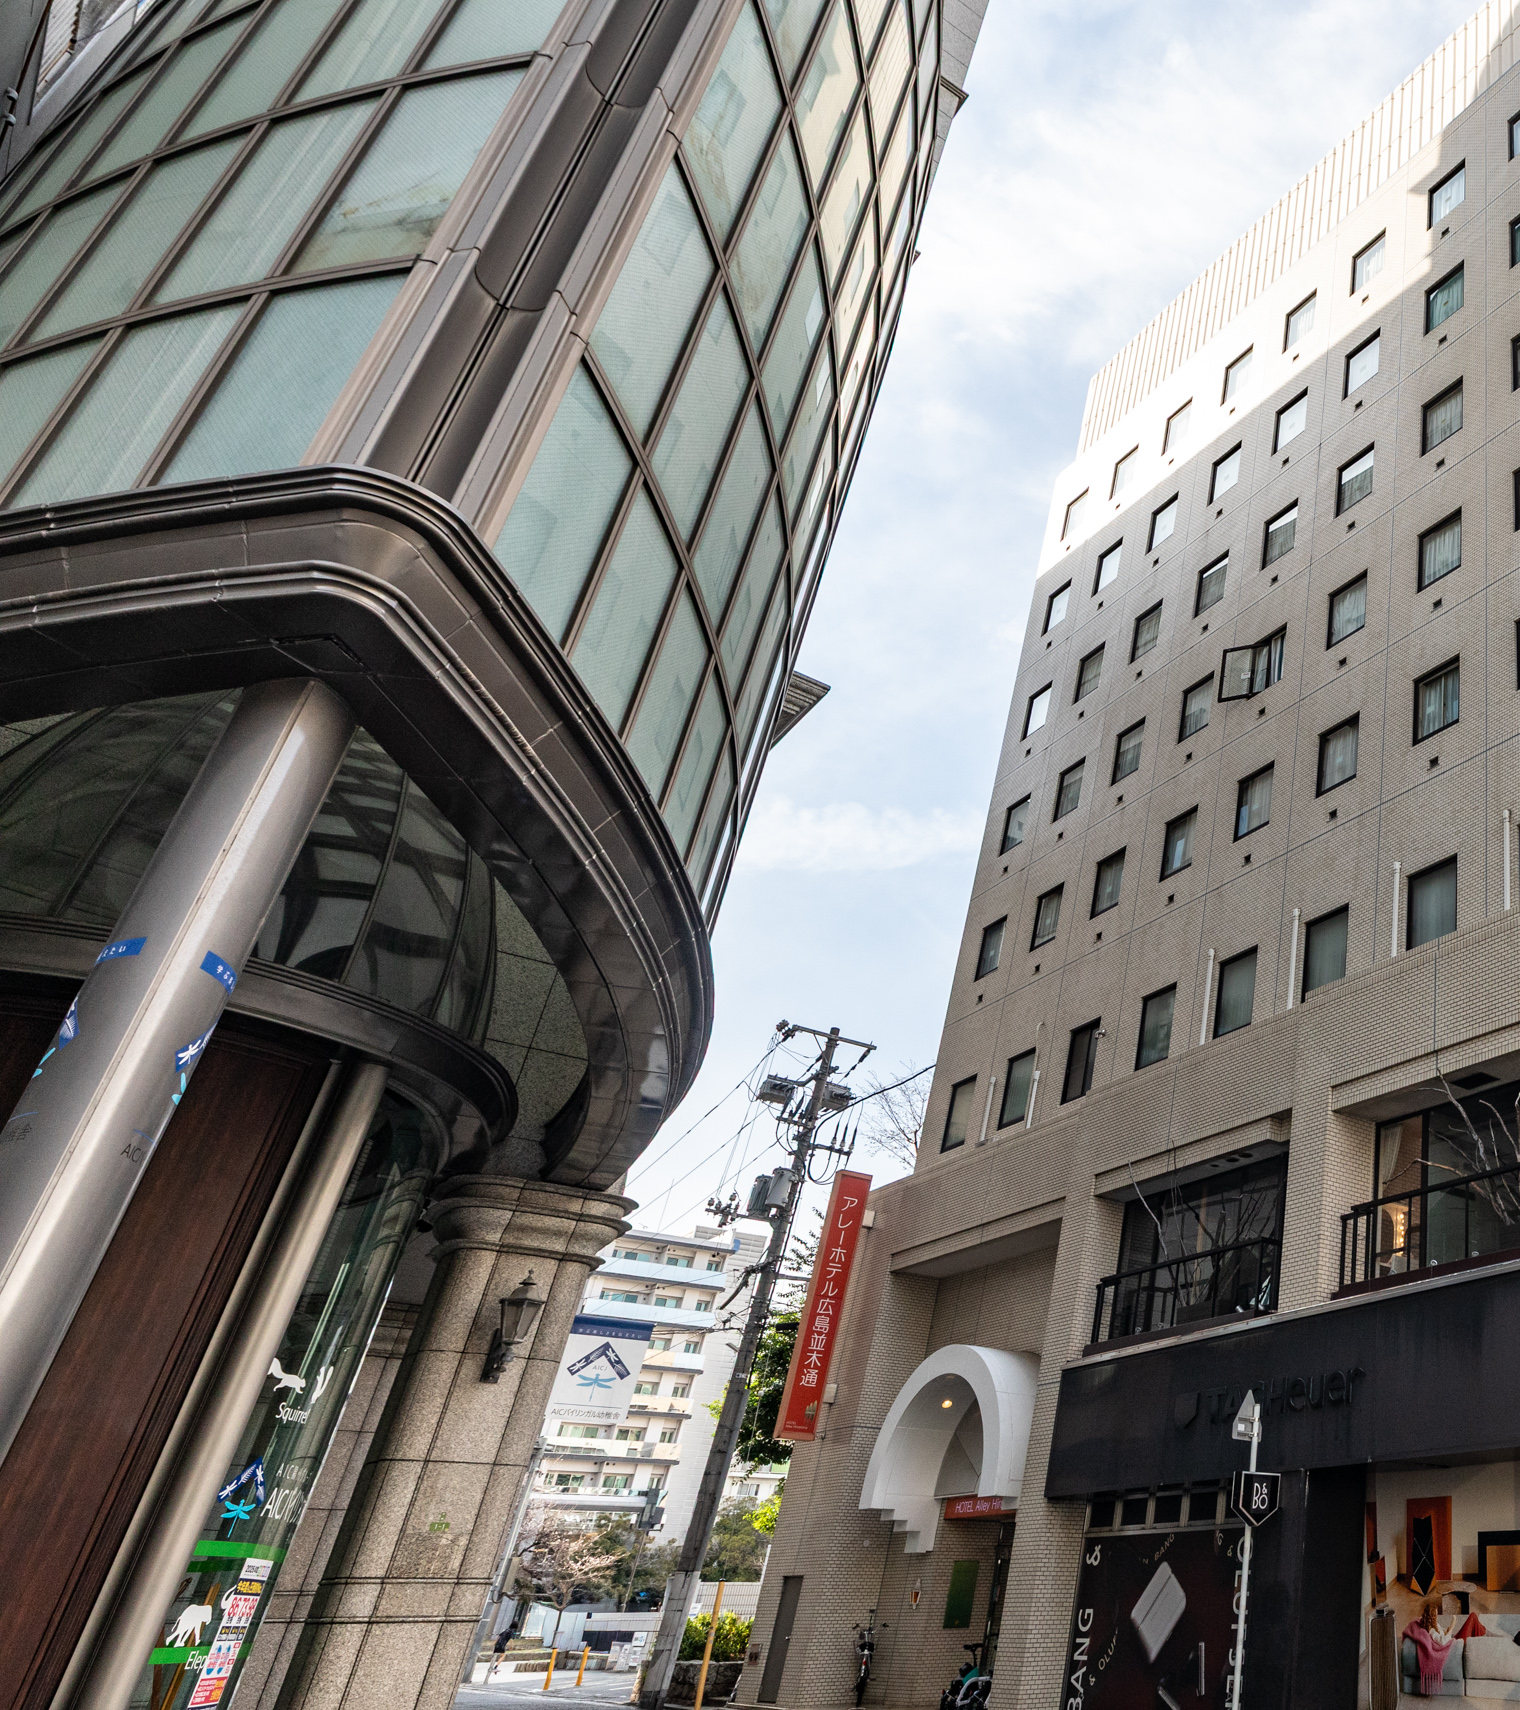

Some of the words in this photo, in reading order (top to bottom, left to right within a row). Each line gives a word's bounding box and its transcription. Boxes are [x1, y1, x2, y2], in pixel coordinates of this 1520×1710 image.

[799, 1195, 859, 1388] アレーホテル広島並木通
[275, 1401, 312, 1425] Squirrel
[550, 1408, 621, 1420] AICバイリンガル幼稚舎
[954, 1500, 974, 1514] HOTEL
[974, 1499, 990, 1513] Alley
[184, 1650, 207, 1674] Elep
